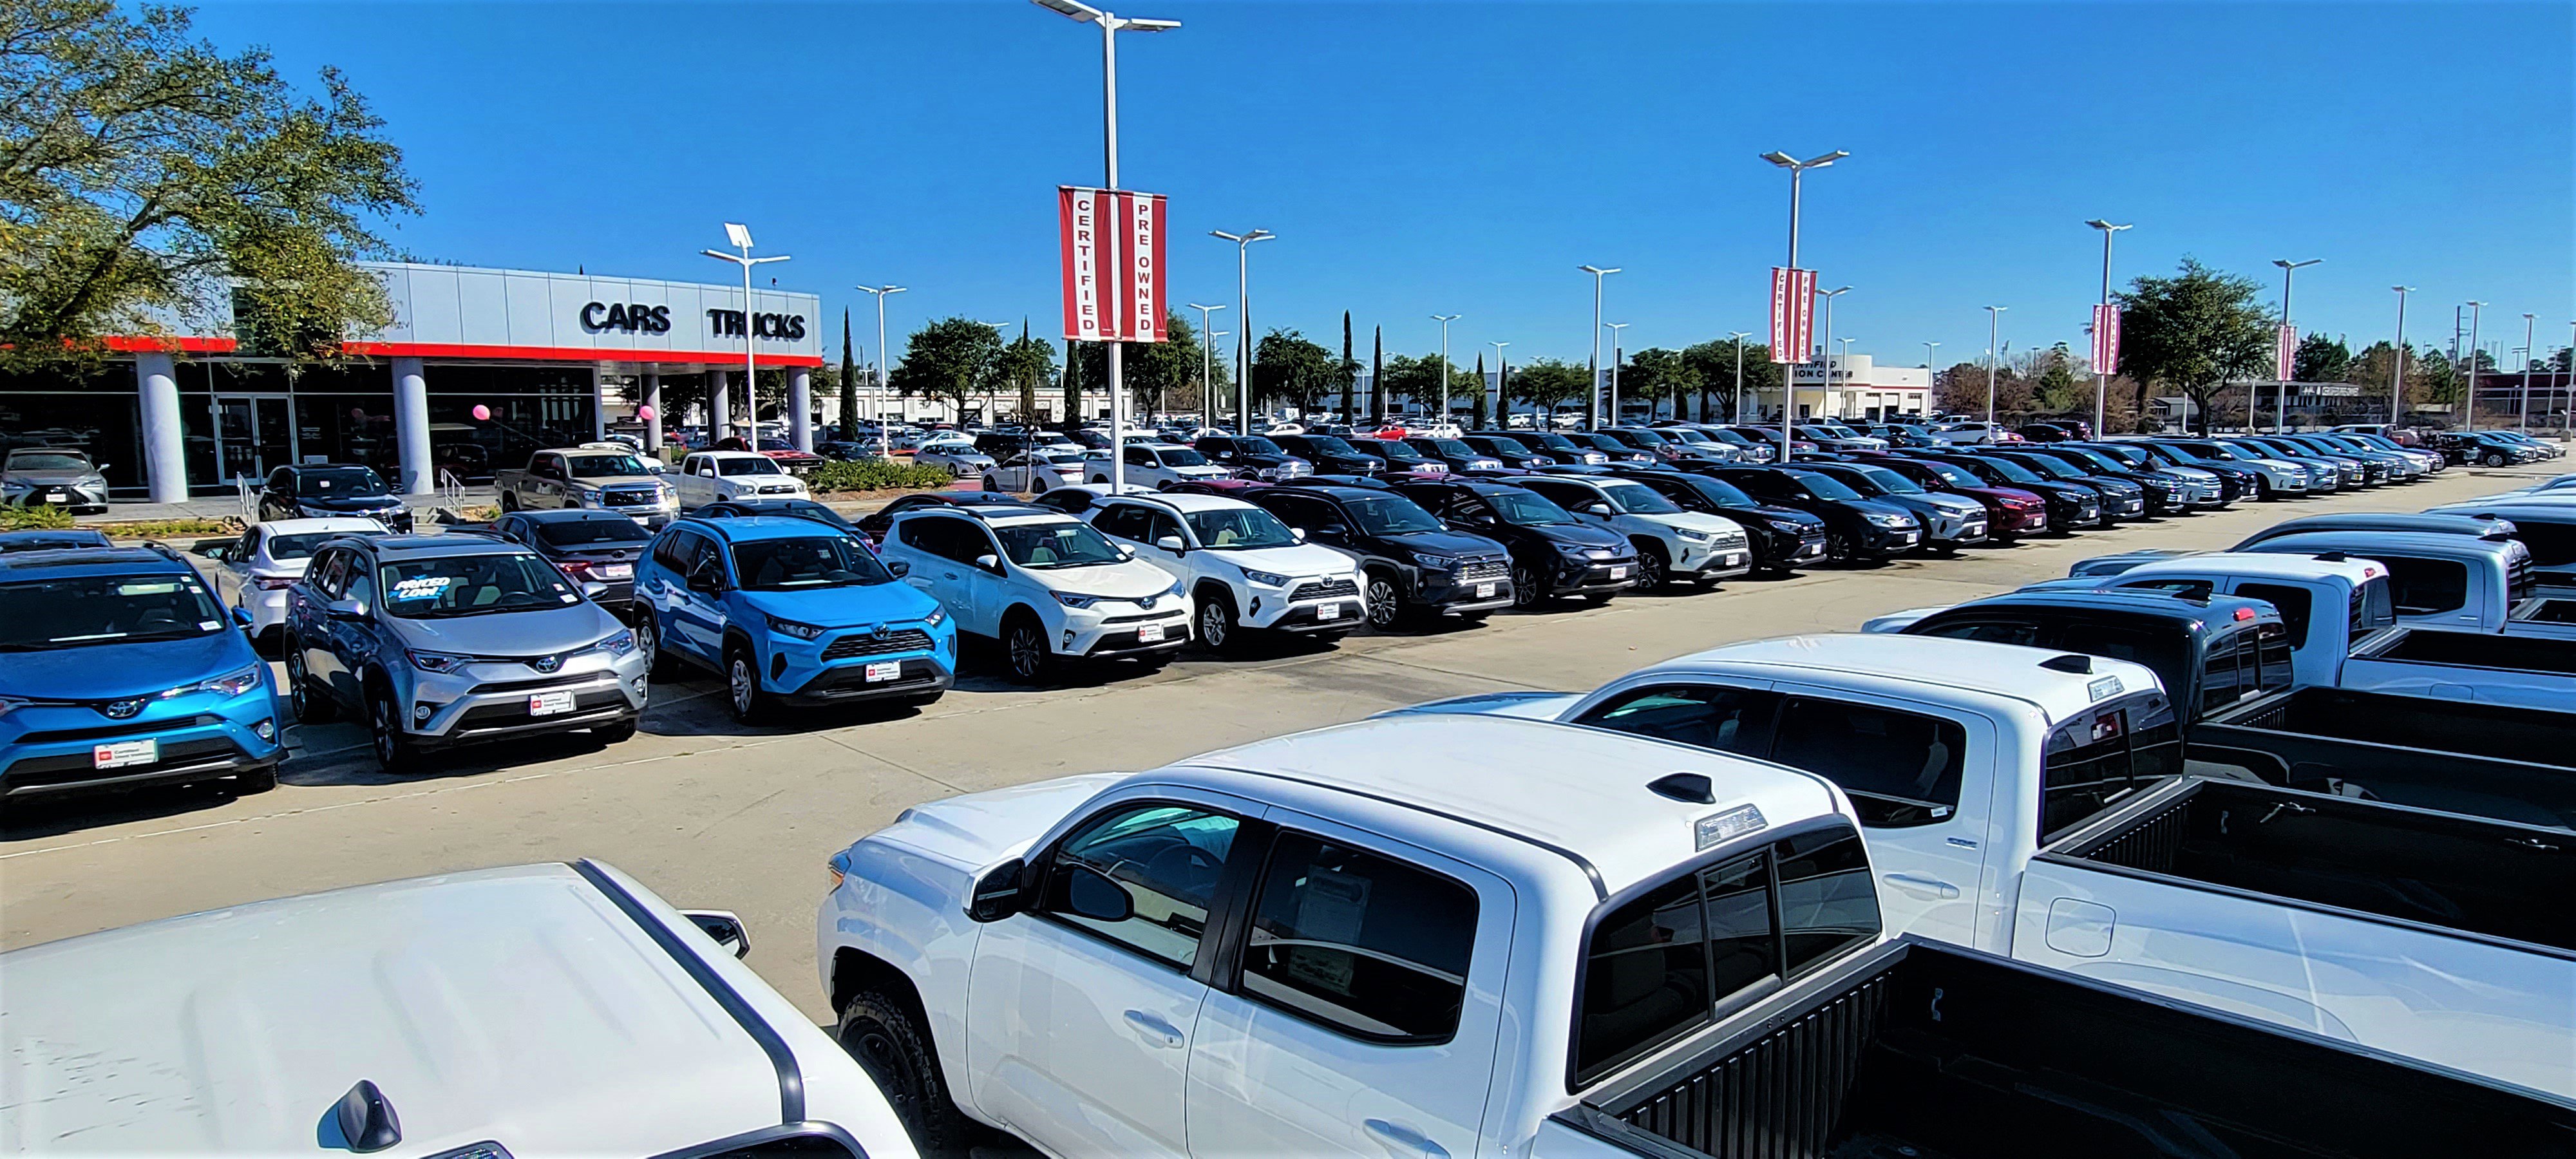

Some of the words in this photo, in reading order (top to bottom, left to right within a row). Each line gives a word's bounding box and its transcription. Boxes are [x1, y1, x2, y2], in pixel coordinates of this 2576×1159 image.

[1139, 204, 1149, 246] PRE
[1077, 200, 1095, 330] CERTIFIED
[1138, 256, 1151, 331] OWNED
[581, 301, 671, 333] CARS
[707, 308, 806, 339] TRUCKS
